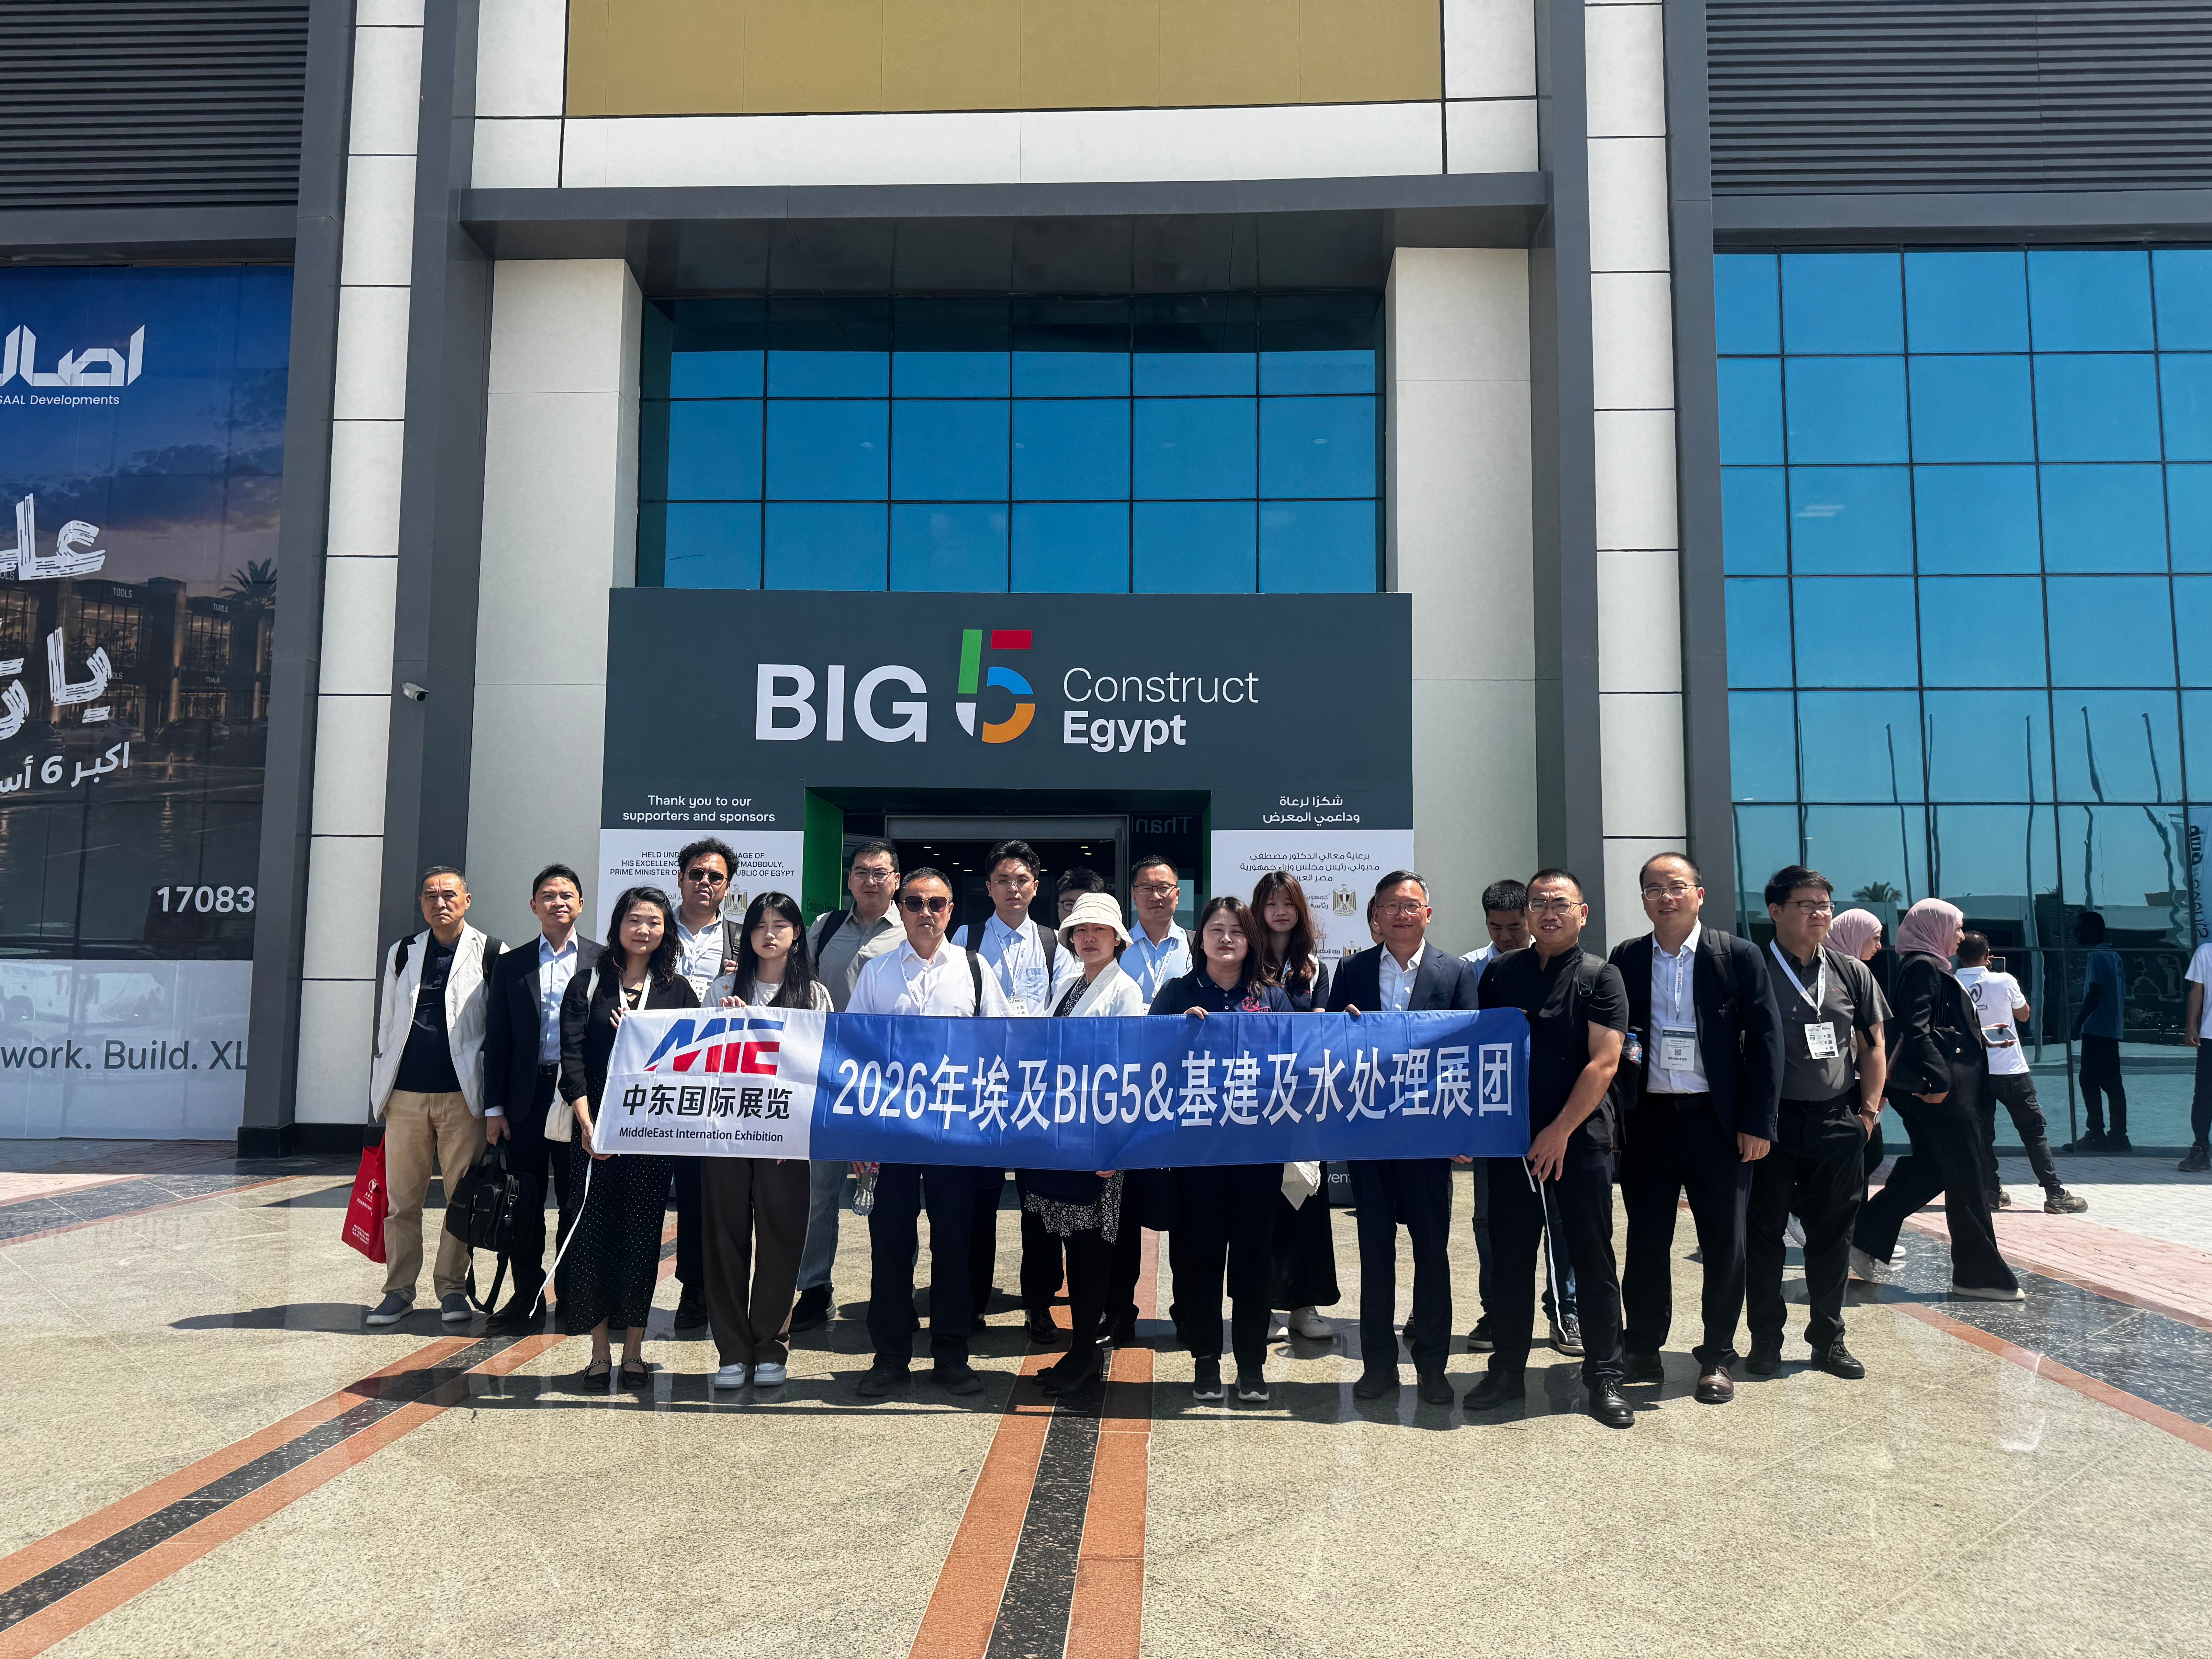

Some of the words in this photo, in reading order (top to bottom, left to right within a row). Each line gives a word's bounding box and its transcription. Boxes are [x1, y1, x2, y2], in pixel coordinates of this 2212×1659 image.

[31, 395, 119, 407] Developments
[756, 664, 927, 742] BIG
[956, 629, 1036, 744] 5
[1064, 668, 1259, 703] Construct
[1064, 711, 1186, 752] Egypt
[41, 756, 63, 783] 6
[648, 795, 685, 805] Thank
[689, 798, 711, 808] you
[716, 797, 728, 805] to
[1280, 796, 1309, 807] لرعاة
[623, 811, 689, 823] supporters
[694, 812, 716, 821] and
[720, 814, 775, 823] sponsors
[1263, 812, 1310, 823] المعرض
[1314, 812, 1360, 826] وداعمي
[1250, 852, 1287, 860] مصطفى
[1319, 853, 1345, 862] معالي
[1346, 852, 1369, 860] برعاية
[157, 886, 254, 912] 17083
[104, 1040, 198, 1070] Build.
[833, 1043, 1513, 1131] 2026年埃及BIG5&基建及水处理展团
[623, 1084, 792, 1119] 中东国际展览
[620, 1127, 673, 1138] MiddleEast
[676, 1128, 732, 1140] Internation
[735, 1130, 783, 1142] Exhibition
